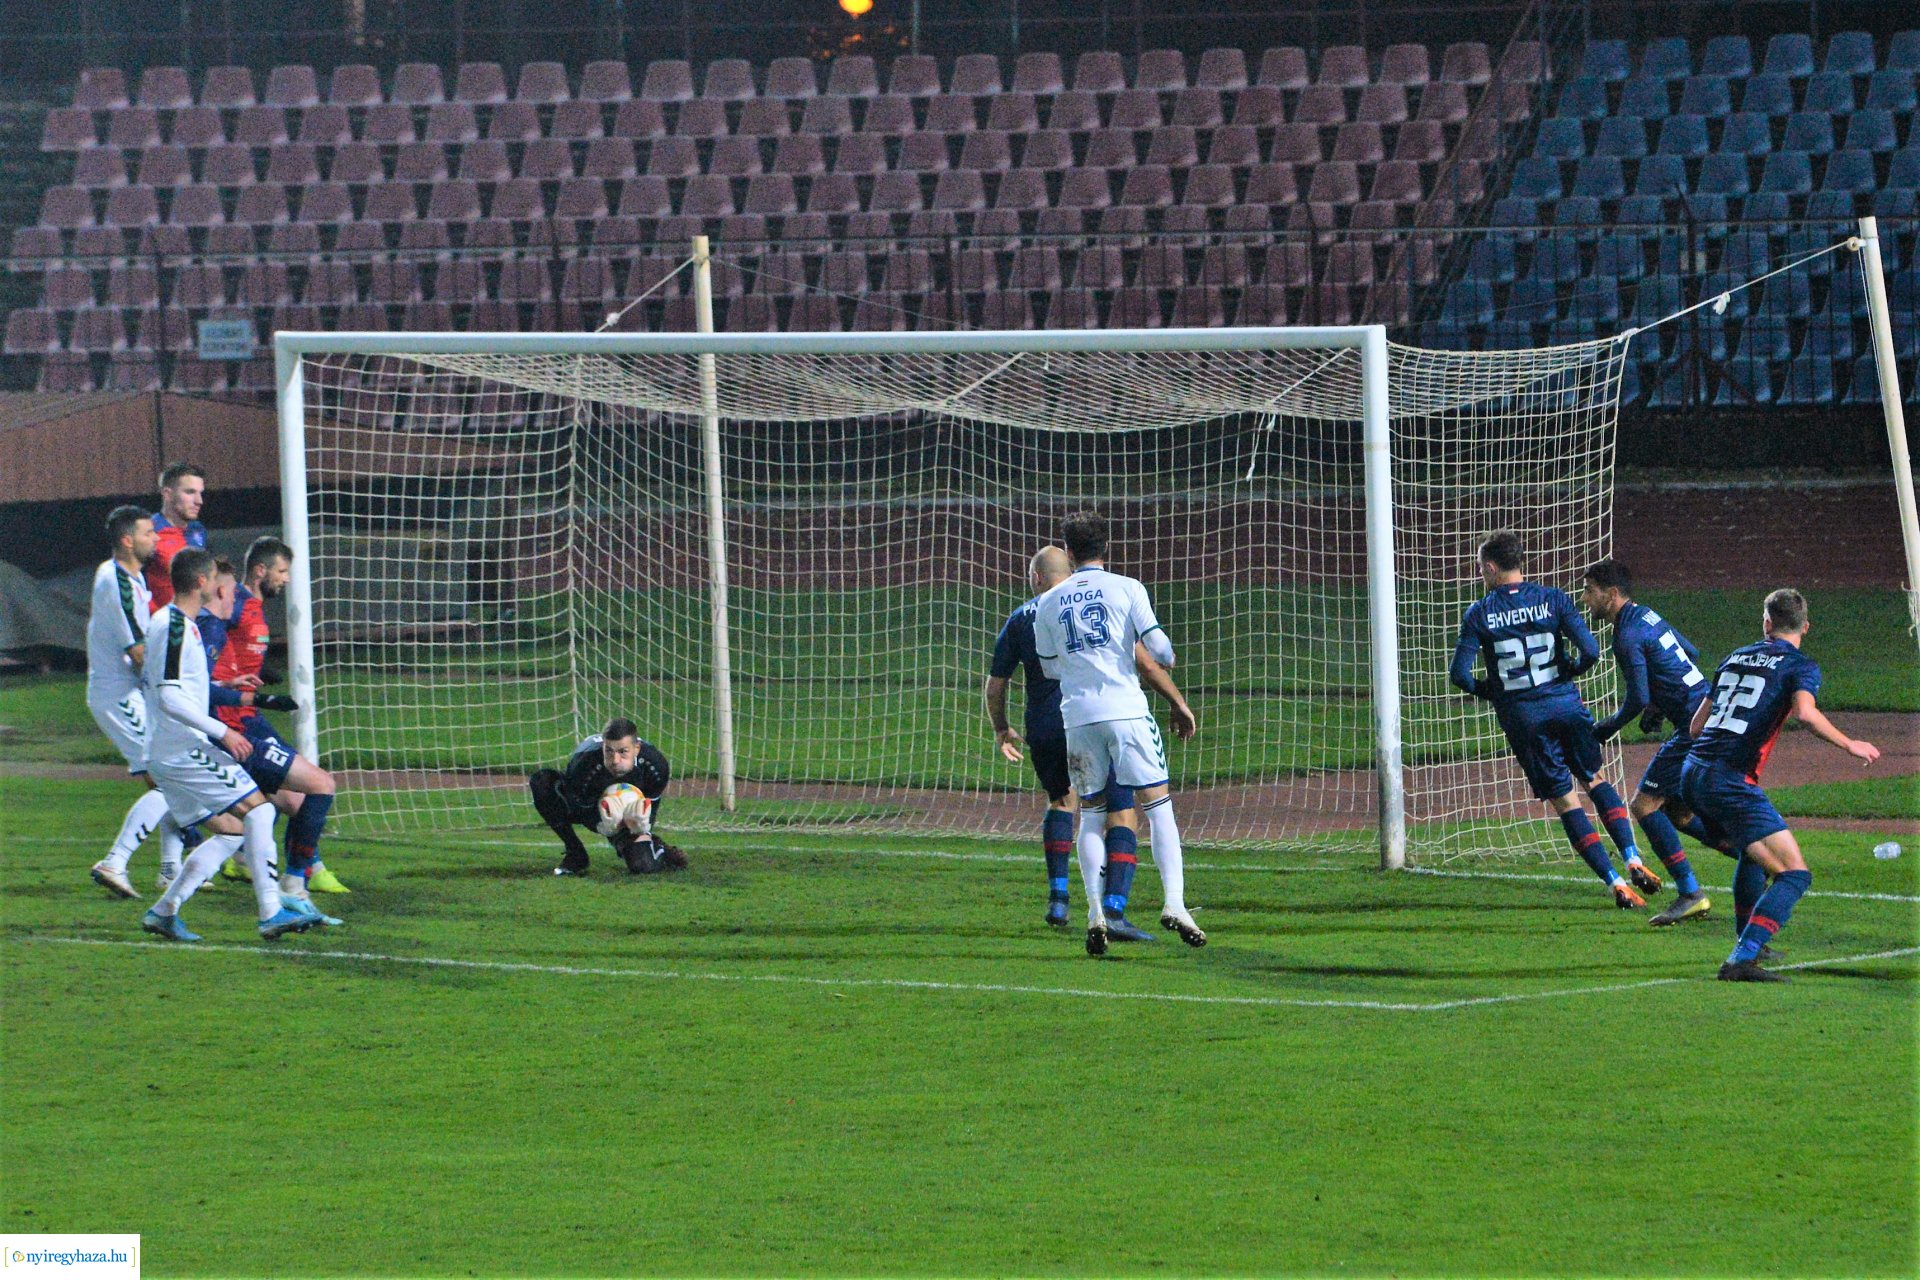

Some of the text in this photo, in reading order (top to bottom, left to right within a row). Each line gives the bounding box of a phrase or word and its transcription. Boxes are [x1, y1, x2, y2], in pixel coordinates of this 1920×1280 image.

[1060, 589, 1104, 606] MOGA
[1487, 602, 1552, 629] SHVEDYUK
[1058, 602, 1111, 655] 13
[1494, 632, 1560, 691] 22
[1703, 671, 1766, 735] 32
